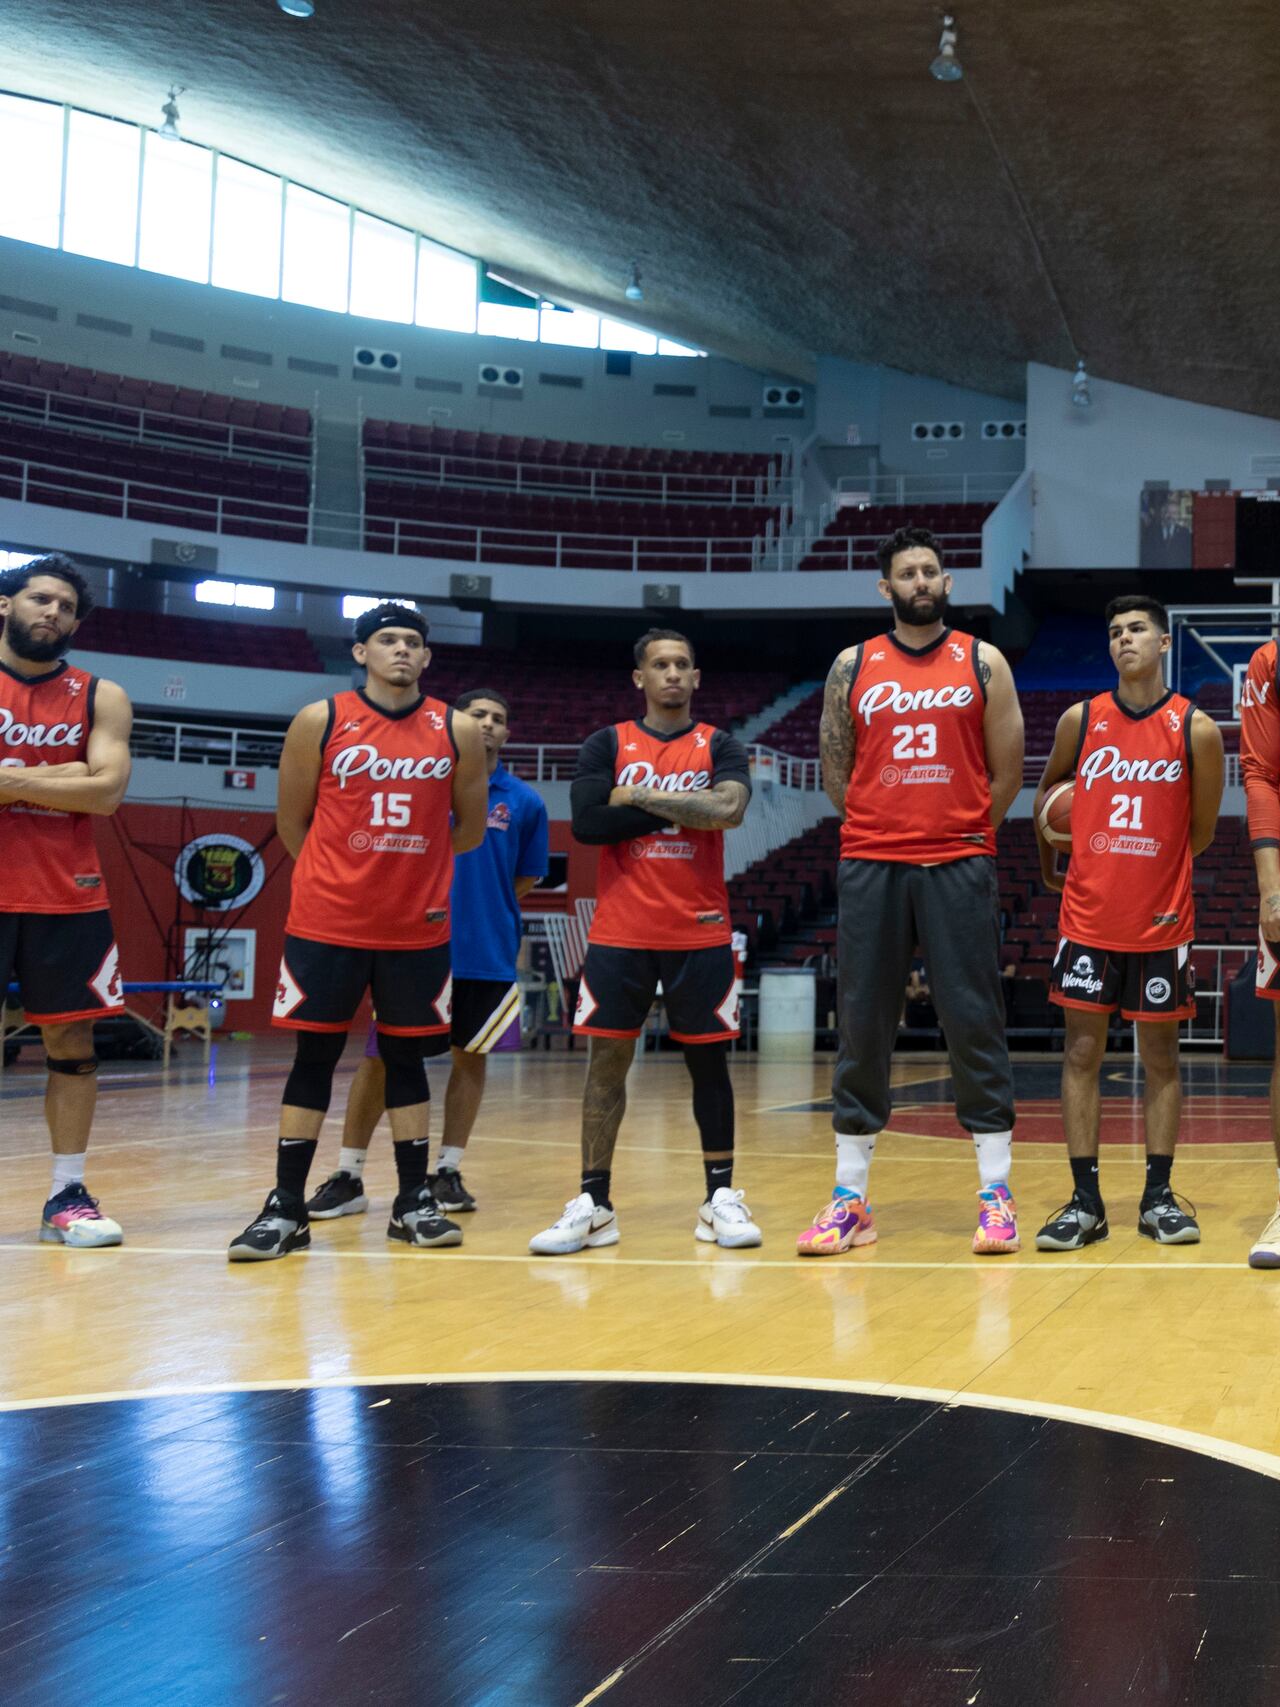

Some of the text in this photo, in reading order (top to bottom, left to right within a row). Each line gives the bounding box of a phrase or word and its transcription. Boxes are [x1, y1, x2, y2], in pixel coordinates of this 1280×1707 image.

[858, 681, 974, 726] Ponce
[892, 723, 937, 759] 23
[232, 772, 248, 788] C
[332, 744, 452, 789] Ponce
[901, 768, 954, 779] TARGET
[1080, 745, 1183, 791] Ponce
[370, 792, 412, 827] 15
[1109, 794, 1143, 830] 21
[372, 836, 430, 850] TARGET
[646, 843, 697, 855] TARGET
[1110, 838, 1162, 852] TARGET
[1061, 972, 1103, 994] Wendy's
